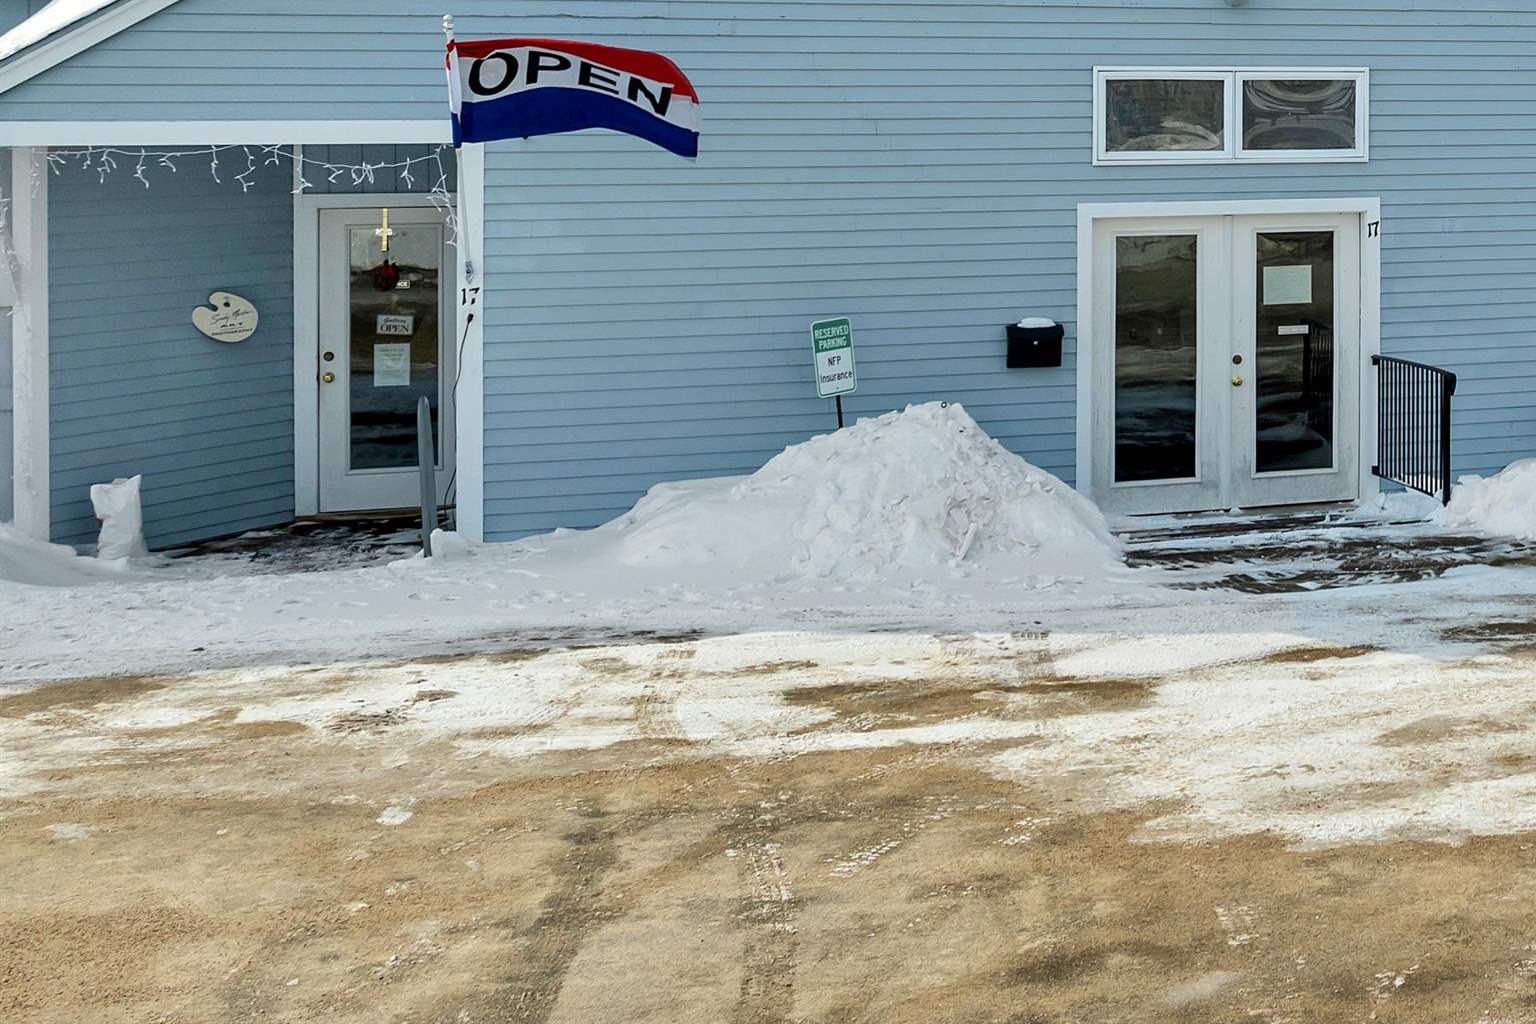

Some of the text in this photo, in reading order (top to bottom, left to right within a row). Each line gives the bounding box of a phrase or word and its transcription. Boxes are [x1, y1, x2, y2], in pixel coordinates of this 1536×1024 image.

[468, 50, 673, 117] OPEN
[1367, 221, 1379, 238] 17
[461, 287, 480, 306] 17
[380, 323, 409, 333] OPEN
[814, 325, 848, 339] RESERVED
[819, 336, 847, 350] PARKING
[827, 355, 842, 367] NFP
